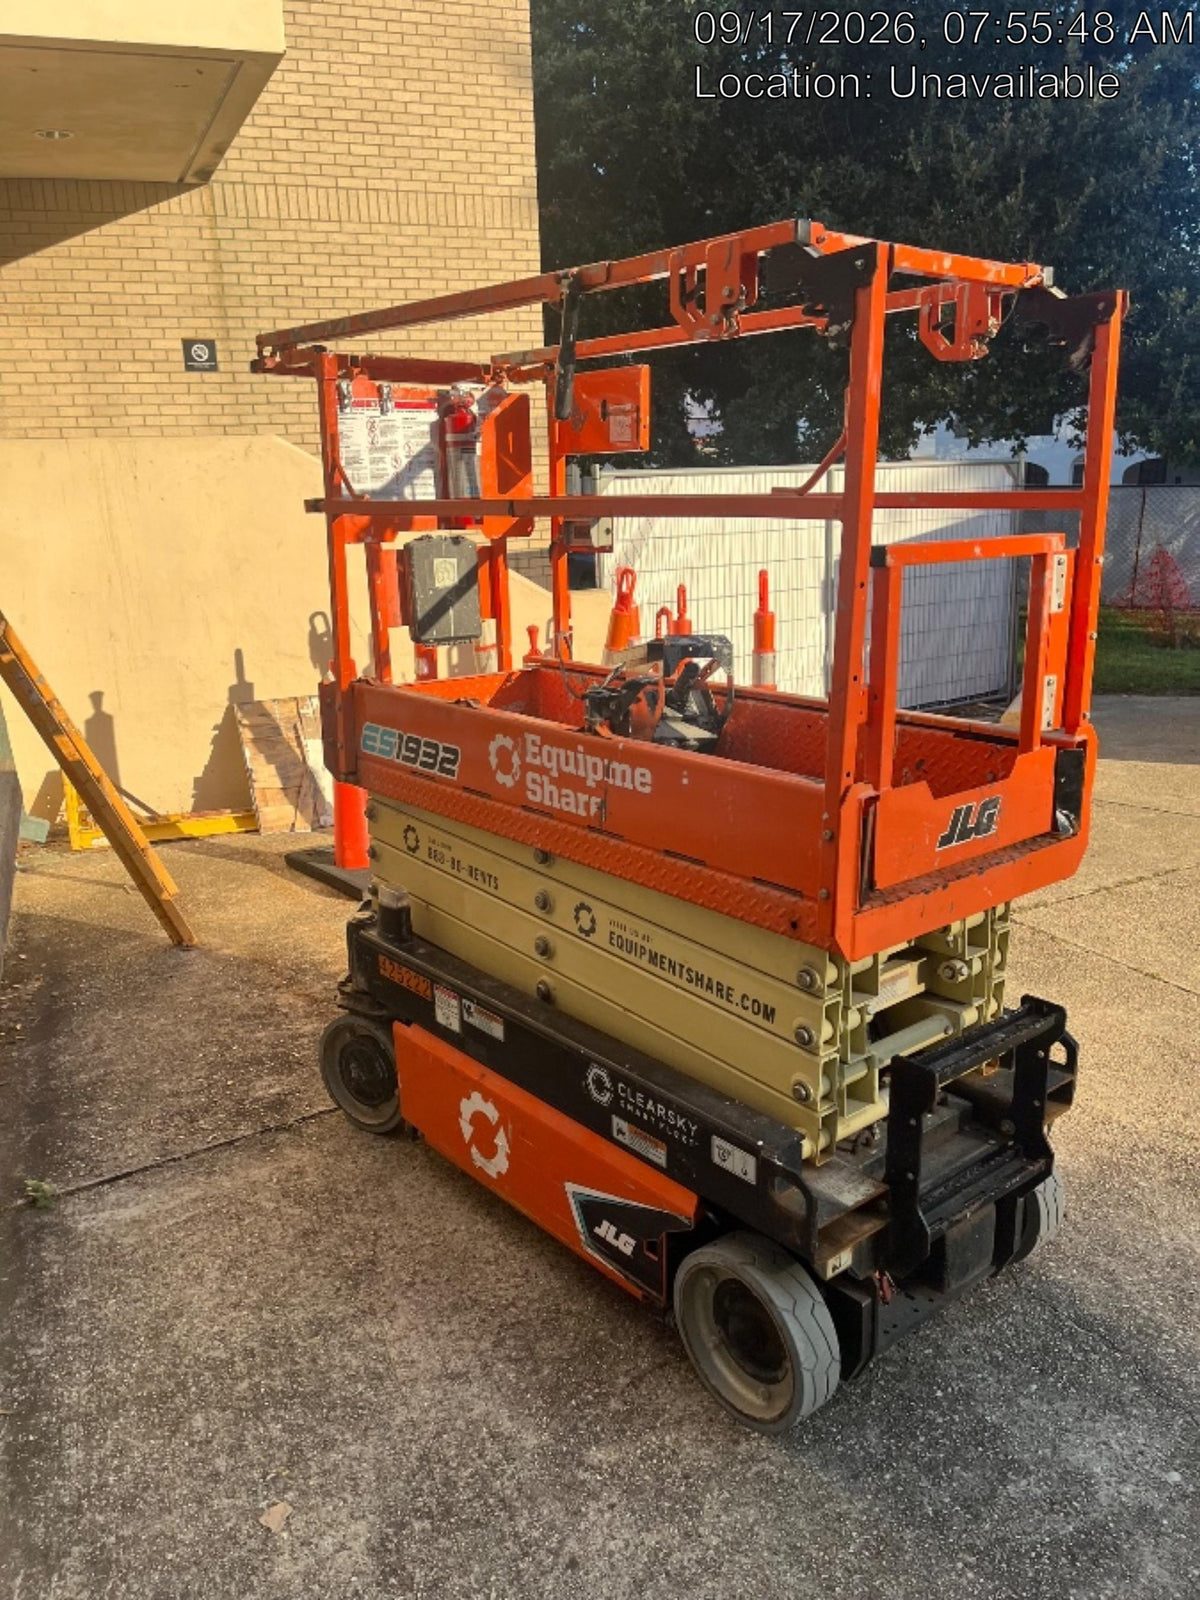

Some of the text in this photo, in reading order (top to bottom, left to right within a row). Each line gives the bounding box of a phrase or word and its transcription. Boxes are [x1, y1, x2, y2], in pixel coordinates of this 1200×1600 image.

[361, 722, 461, 780] ES1932
[935, 795, 1002, 852] JLG
[608, 930, 776, 1025] EQUIPMENTSHARE.COM
[618, 1082, 698, 1137] CLEARSKY
[593, 1219, 637, 1257] JLG
